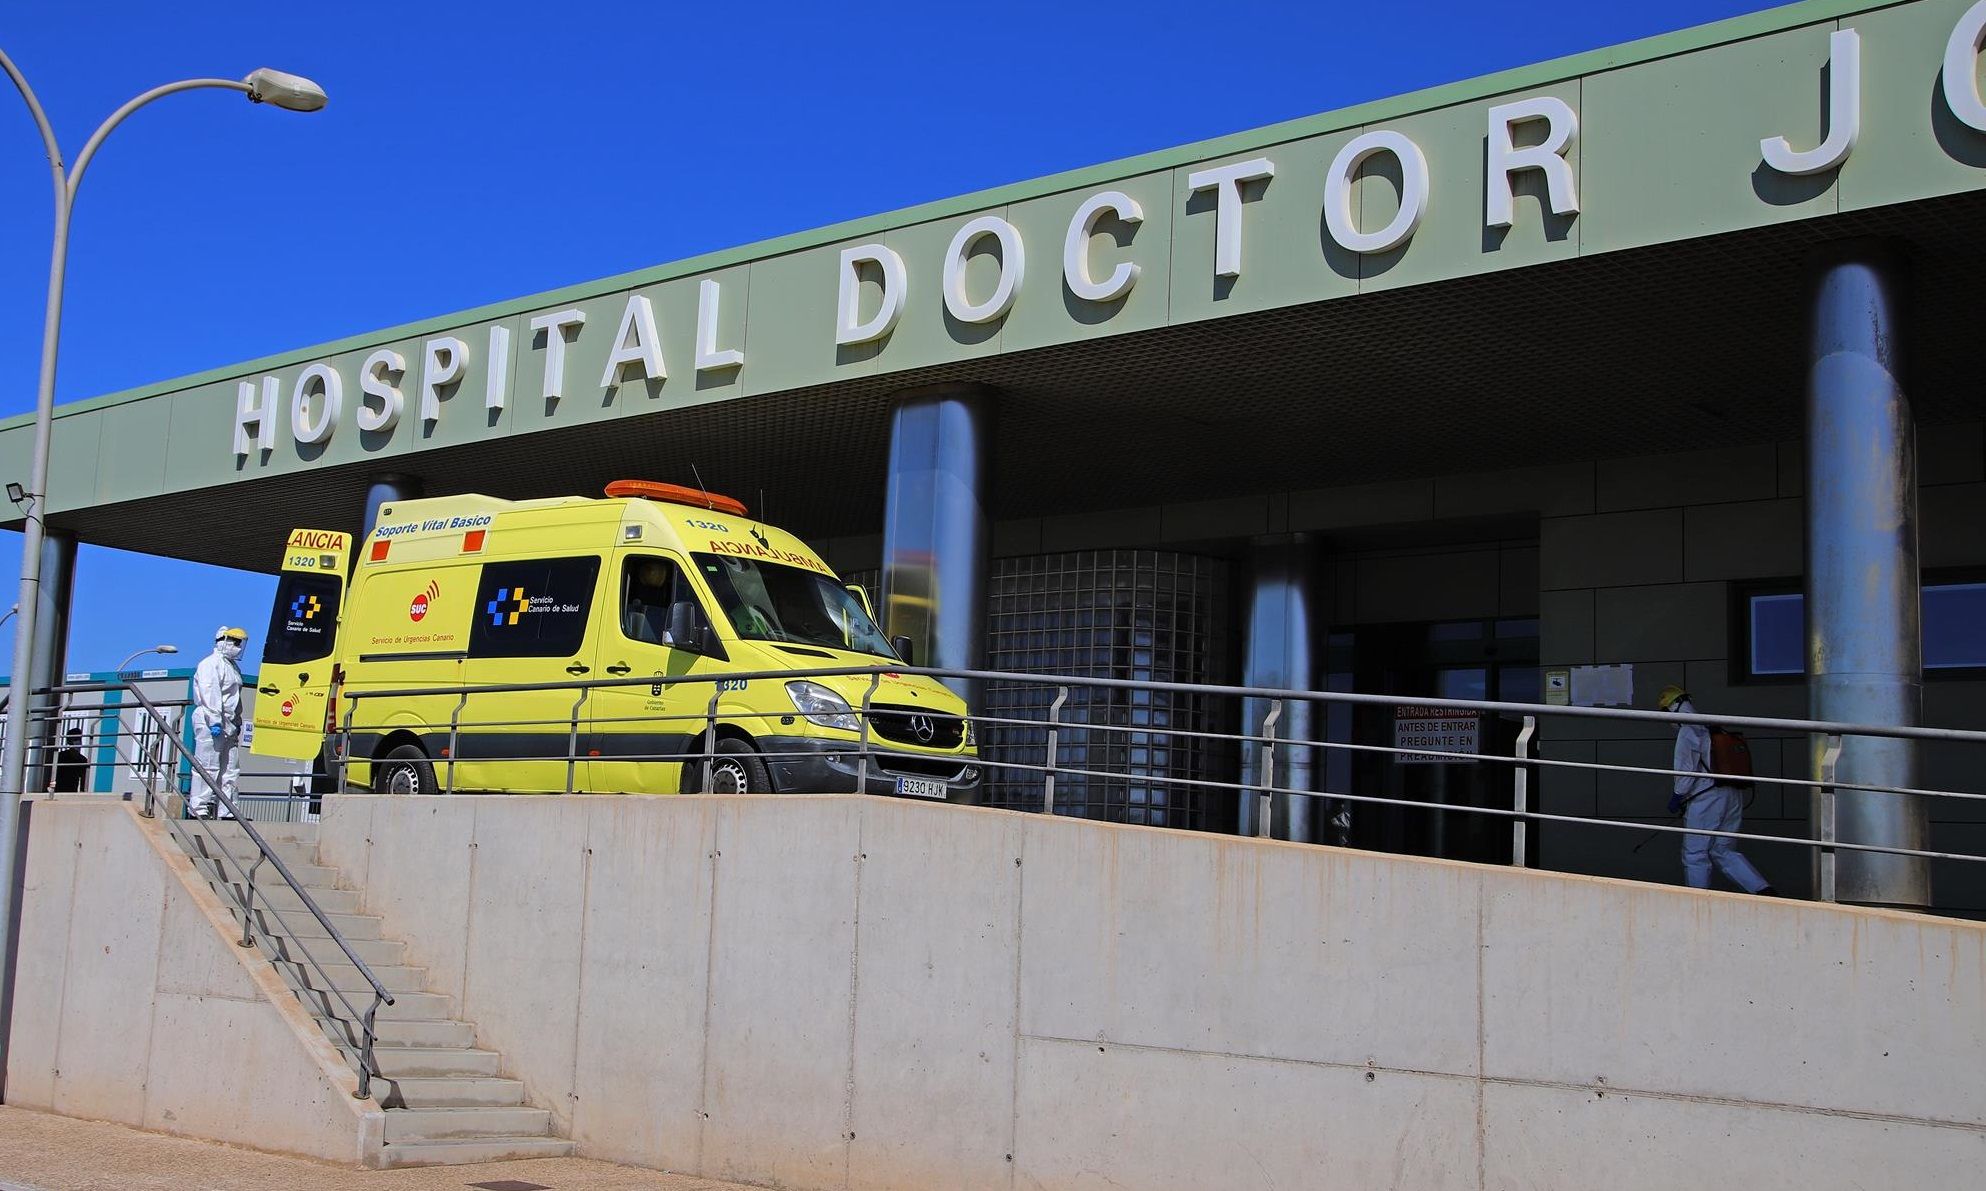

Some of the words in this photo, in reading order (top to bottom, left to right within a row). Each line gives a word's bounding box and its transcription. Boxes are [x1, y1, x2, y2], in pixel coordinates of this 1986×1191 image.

[233, 278, 744, 455] HOSPITAL
[836, 96, 1579, 346] DOCTOR
[376, 524, 418, 538] Soporte
[422, 518, 449, 531] Vital
[450, 515, 491, 528] Básico
[686, 519, 729, 532] 1320
[289, 555, 316, 567] 1320
[529, 596, 554, 604] Servicio
[411, 605, 427, 614] SUC
[528, 604, 551, 612] Canario
[552, 604, 561, 612] de
[562, 604, 579, 612] Salud
[371, 636, 393, 644] Servicio
[403, 634, 431, 645] Urgencias
[432, 633, 455, 642] Canario
[1397, 705, 1429, 717] ENTRADA
[1398, 722, 1426, 732] ANTES
[1427, 722, 1439, 732] DE
[1441, 721, 1476, 731] ENTRAR
[1400, 736, 1454, 746] PREGUNTE
[1460, 736, 1473, 745] EN
[903, 780, 926, 794] 9230
[927, 782, 944, 796] HJK
